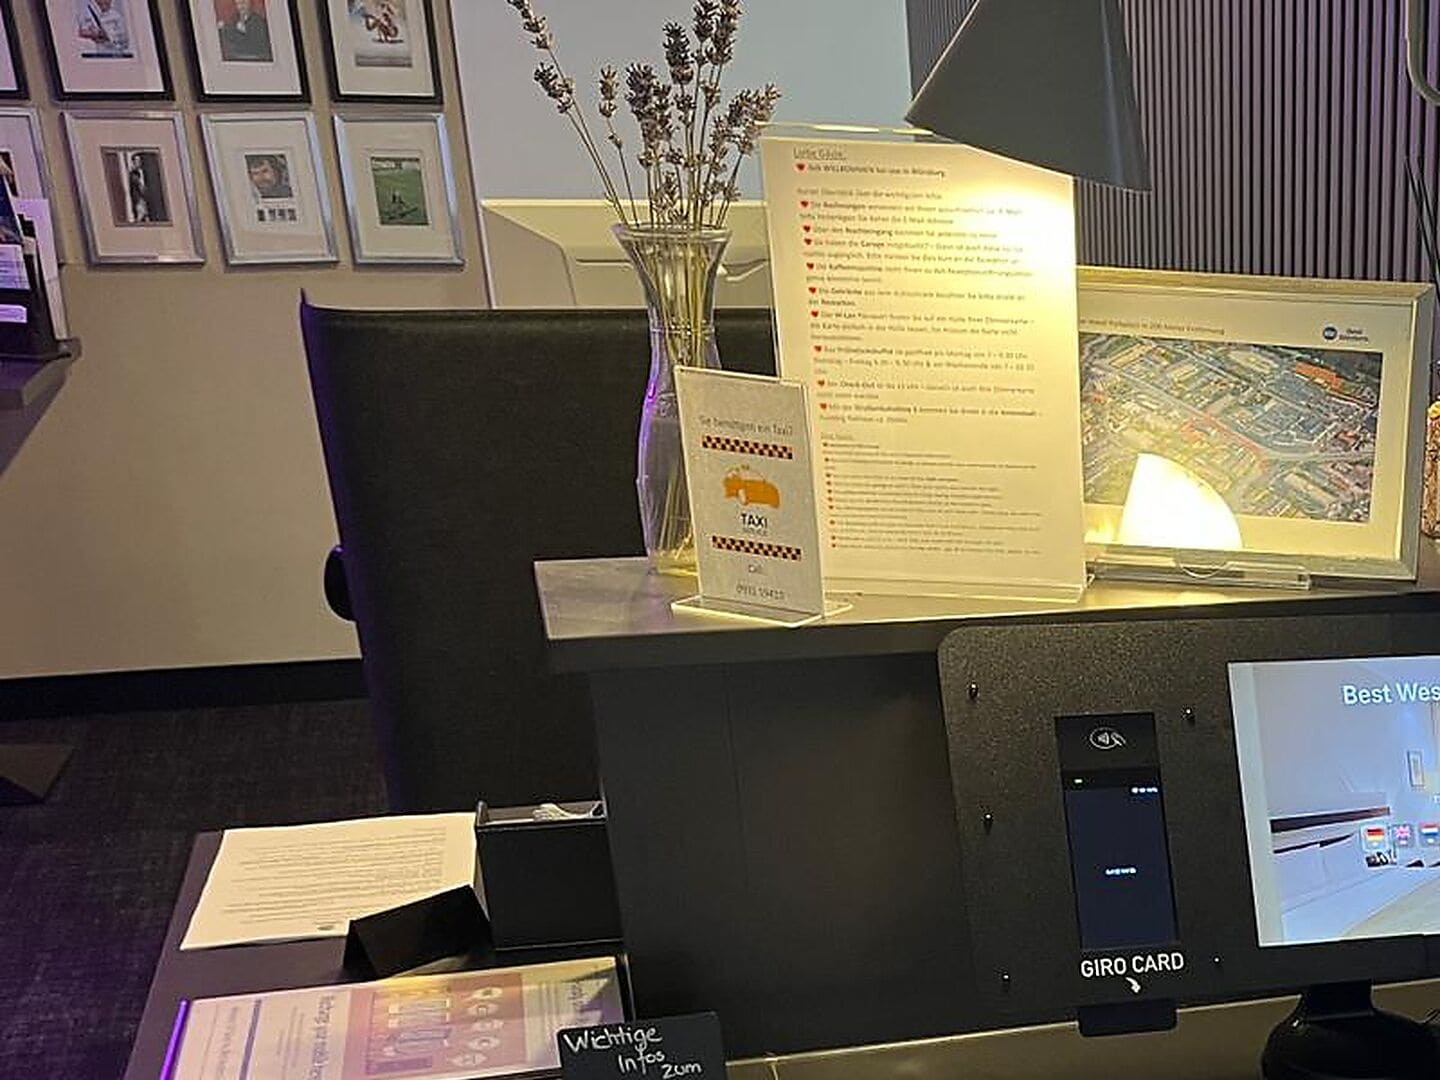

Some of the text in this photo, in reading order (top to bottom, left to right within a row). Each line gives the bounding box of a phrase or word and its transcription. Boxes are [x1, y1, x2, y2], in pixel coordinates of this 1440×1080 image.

[741, 513, 767, 528] TAXI
[1343, 684, 1391, 704] Best
[1081, 952, 1185, 978] GIRO CARD
[563, 1026, 663, 1052] Wichtige
[618, 1050, 665, 1075] Infos
